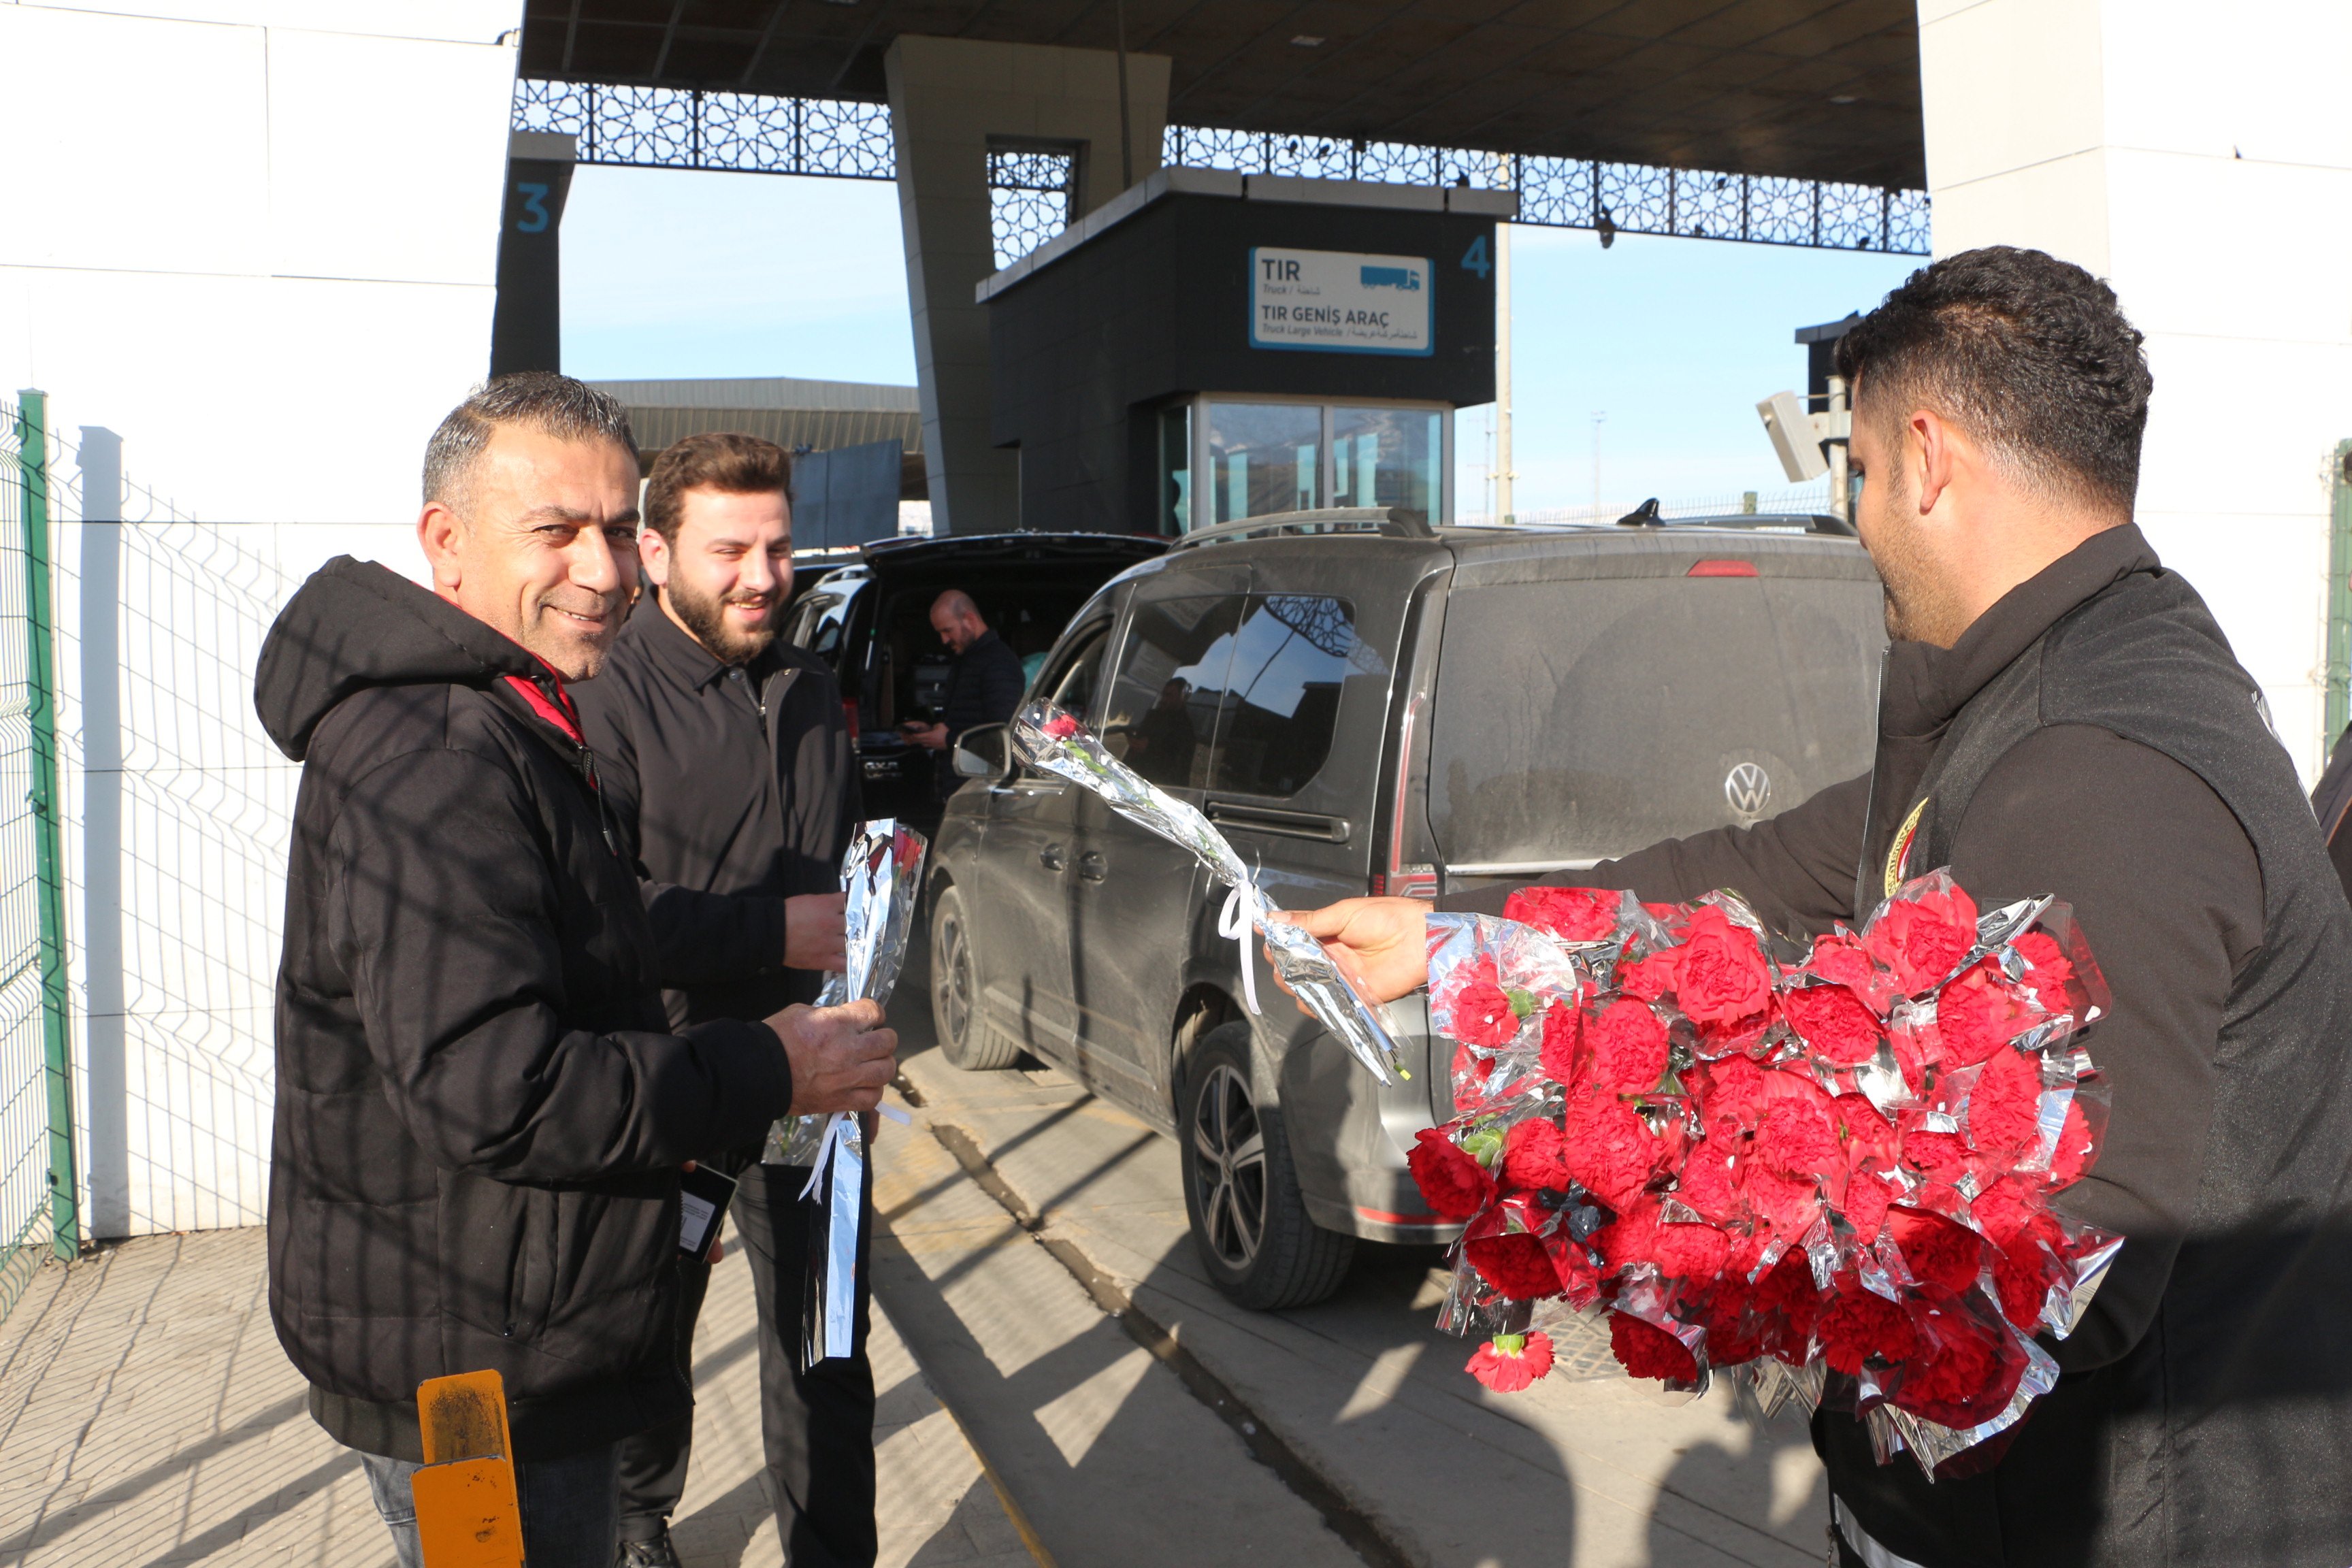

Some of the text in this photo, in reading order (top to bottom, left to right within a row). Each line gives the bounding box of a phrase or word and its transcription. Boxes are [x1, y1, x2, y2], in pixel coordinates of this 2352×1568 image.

[517, 182, 549, 233] 3
[1461, 235, 1490, 279] 4
[1262, 259, 1301, 281] TIR
[1262, 284, 1287, 295] Truck
[1262, 305, 1389, 327] TIR GENİŞ ARAÇ
[1262, 323, 1285, 334] Truck
[1288, 325, 1311, 337] Large
[1314, 327, 1343, 336] Vehicle
